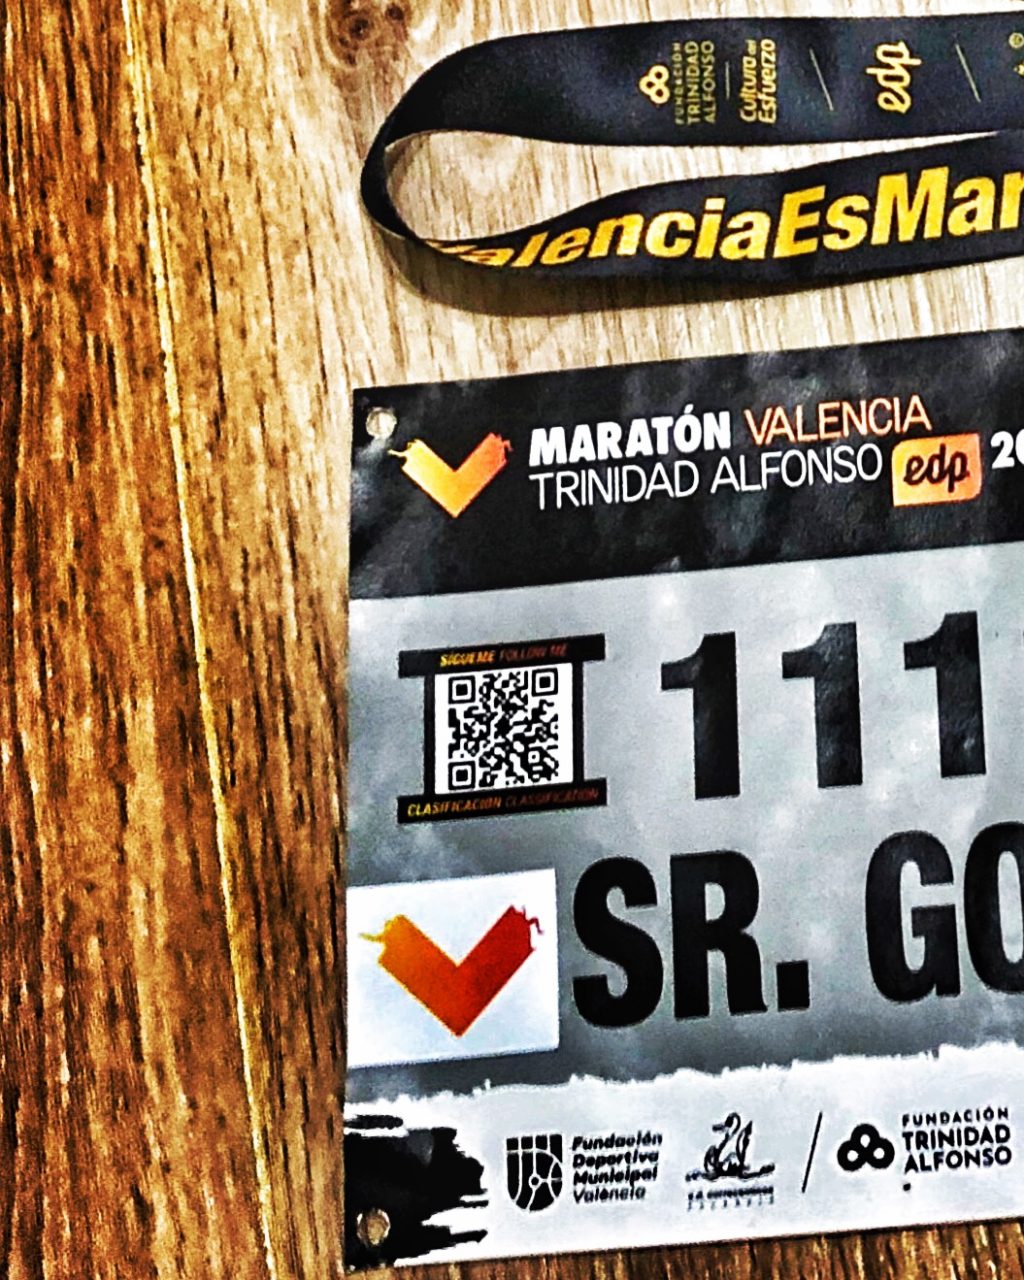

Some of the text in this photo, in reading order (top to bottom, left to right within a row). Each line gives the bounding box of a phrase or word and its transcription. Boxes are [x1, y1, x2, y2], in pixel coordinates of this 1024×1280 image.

[685, 40, 701, 126] TRINIDAD
[701, 39, 716, 124] ALFONSO
[739, 56, 757, 123] Cultura
[758, 37, 777, 125] Esfuerzo
[865, 41, 922, 114] edp
[530, 396, 933, 468] MARATÓN VALENCIA
[530, 461, 701, 512] TRINIDAD
[709, 443, 883, 494] ALFONSO
[903, 442, 971, 497] edp
[571, 848, 812, 1032] SR.
[572, 1129, 663, 1151] Fundación
[902, 1105, 1009, 1128] FUNDACIÓN
[902, 1123, 1012, 1151] TRINIDAD
[572, 1149, 659, 1170] Deportiva
[573, 1162, 659, 1187] Municipal
[903, 1145, 1013, 1175] ALFONSO
